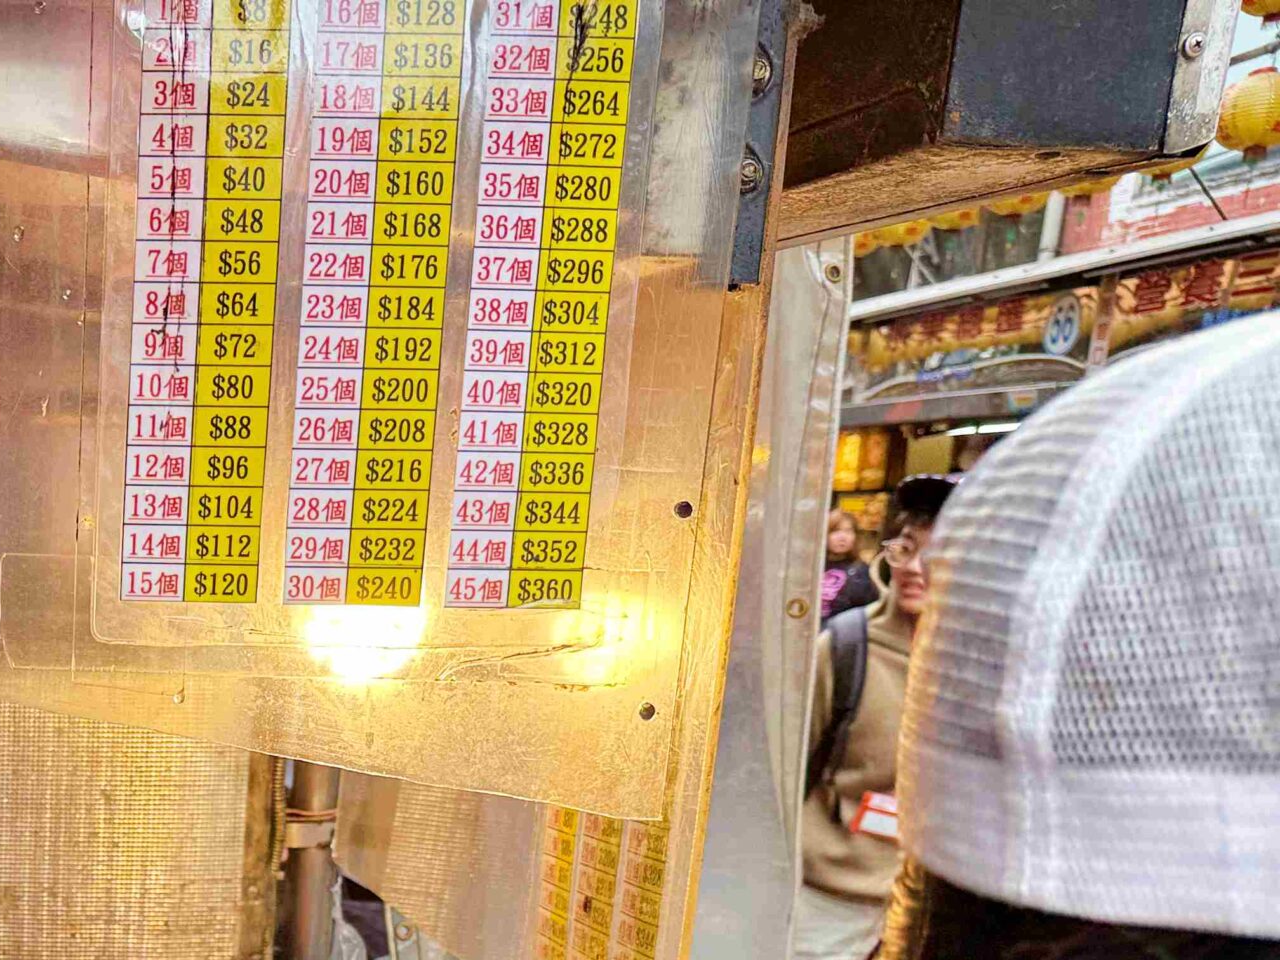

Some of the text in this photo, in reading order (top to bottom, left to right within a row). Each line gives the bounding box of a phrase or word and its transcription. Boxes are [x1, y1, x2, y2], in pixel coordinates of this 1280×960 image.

[160, 0, 198, 23] 1個
[324, 0, 455, 27] 16個 $128
[497, 2, 553, 28] 31個
[229, 39, 272, 64] $16
[323, 42, 452, 69] 17個 $136
[493, 45, 623, 73] 32個 $256
[154, 81, 269, 107] 3個 $24
[321, 85, 449, 113] 18個 $144
[491, 87, 620, 116] 33個 $264
[152, 123, 268, 150] 4個 $32
[318, 127, 447, 155] 19個 $152
[487, 130, 616, 159] 34個 $272
[151, 165, 265, 192] 5個 $40
[314, 169, 443, 197] 20個 $160
[484, 173, 611, 201] 35個 $280
[149, 208, 263, 235] 6個 $48
[312, 211, 441, 239] 21個 $168
[481, 215, 608, 243] 36個 $288
[148, 250, 261, 276] 7個 $56
[310, 253, 438, 280] 22個 $176
[478, 257, 603, 284] 37個 $296
[145, 291, 258, 318] 8個 $64
[307, 294, 434, 322] 23個 $184
[475, 298, 599, 325] 38個 $304
[145, 333, 256, 359] 9個 $72
[304, 335, 432, 363] 24個 $192
[471, 339, 596, 367] 39個 $312
[136, 374, 253, 400] 10個 $80
[302, 377, 428, 403] 25個 $200
[467, 379, 592, 407] 40個 $320
[134, 415, 251, 440] 11個 $88
[299, 417, 425, 444] 26個 $208
[464, 419, 588, 447] 41個 $328
[133, 454, 248, 480] 12個 $96
[296, 458, 422, 484] 27個 $216
[460, 460, 584, 487] 42個 $336
[131, 494, 253, 519] 13個 $104
[294, 498, 418, 523] 28個 $224
[457, 500, 580, 526] 43個 $344
[130, 533, 251, 558] 14個 $112
[291, 537, 415, 562] 29個 $232
[453, 539, 577, 565] 44個 $352
[128, 569, 248, 597] 15個 $120
[288, 575, 412, 601] 30個 $240
[450, 578, 572, 603] 45個 $360
